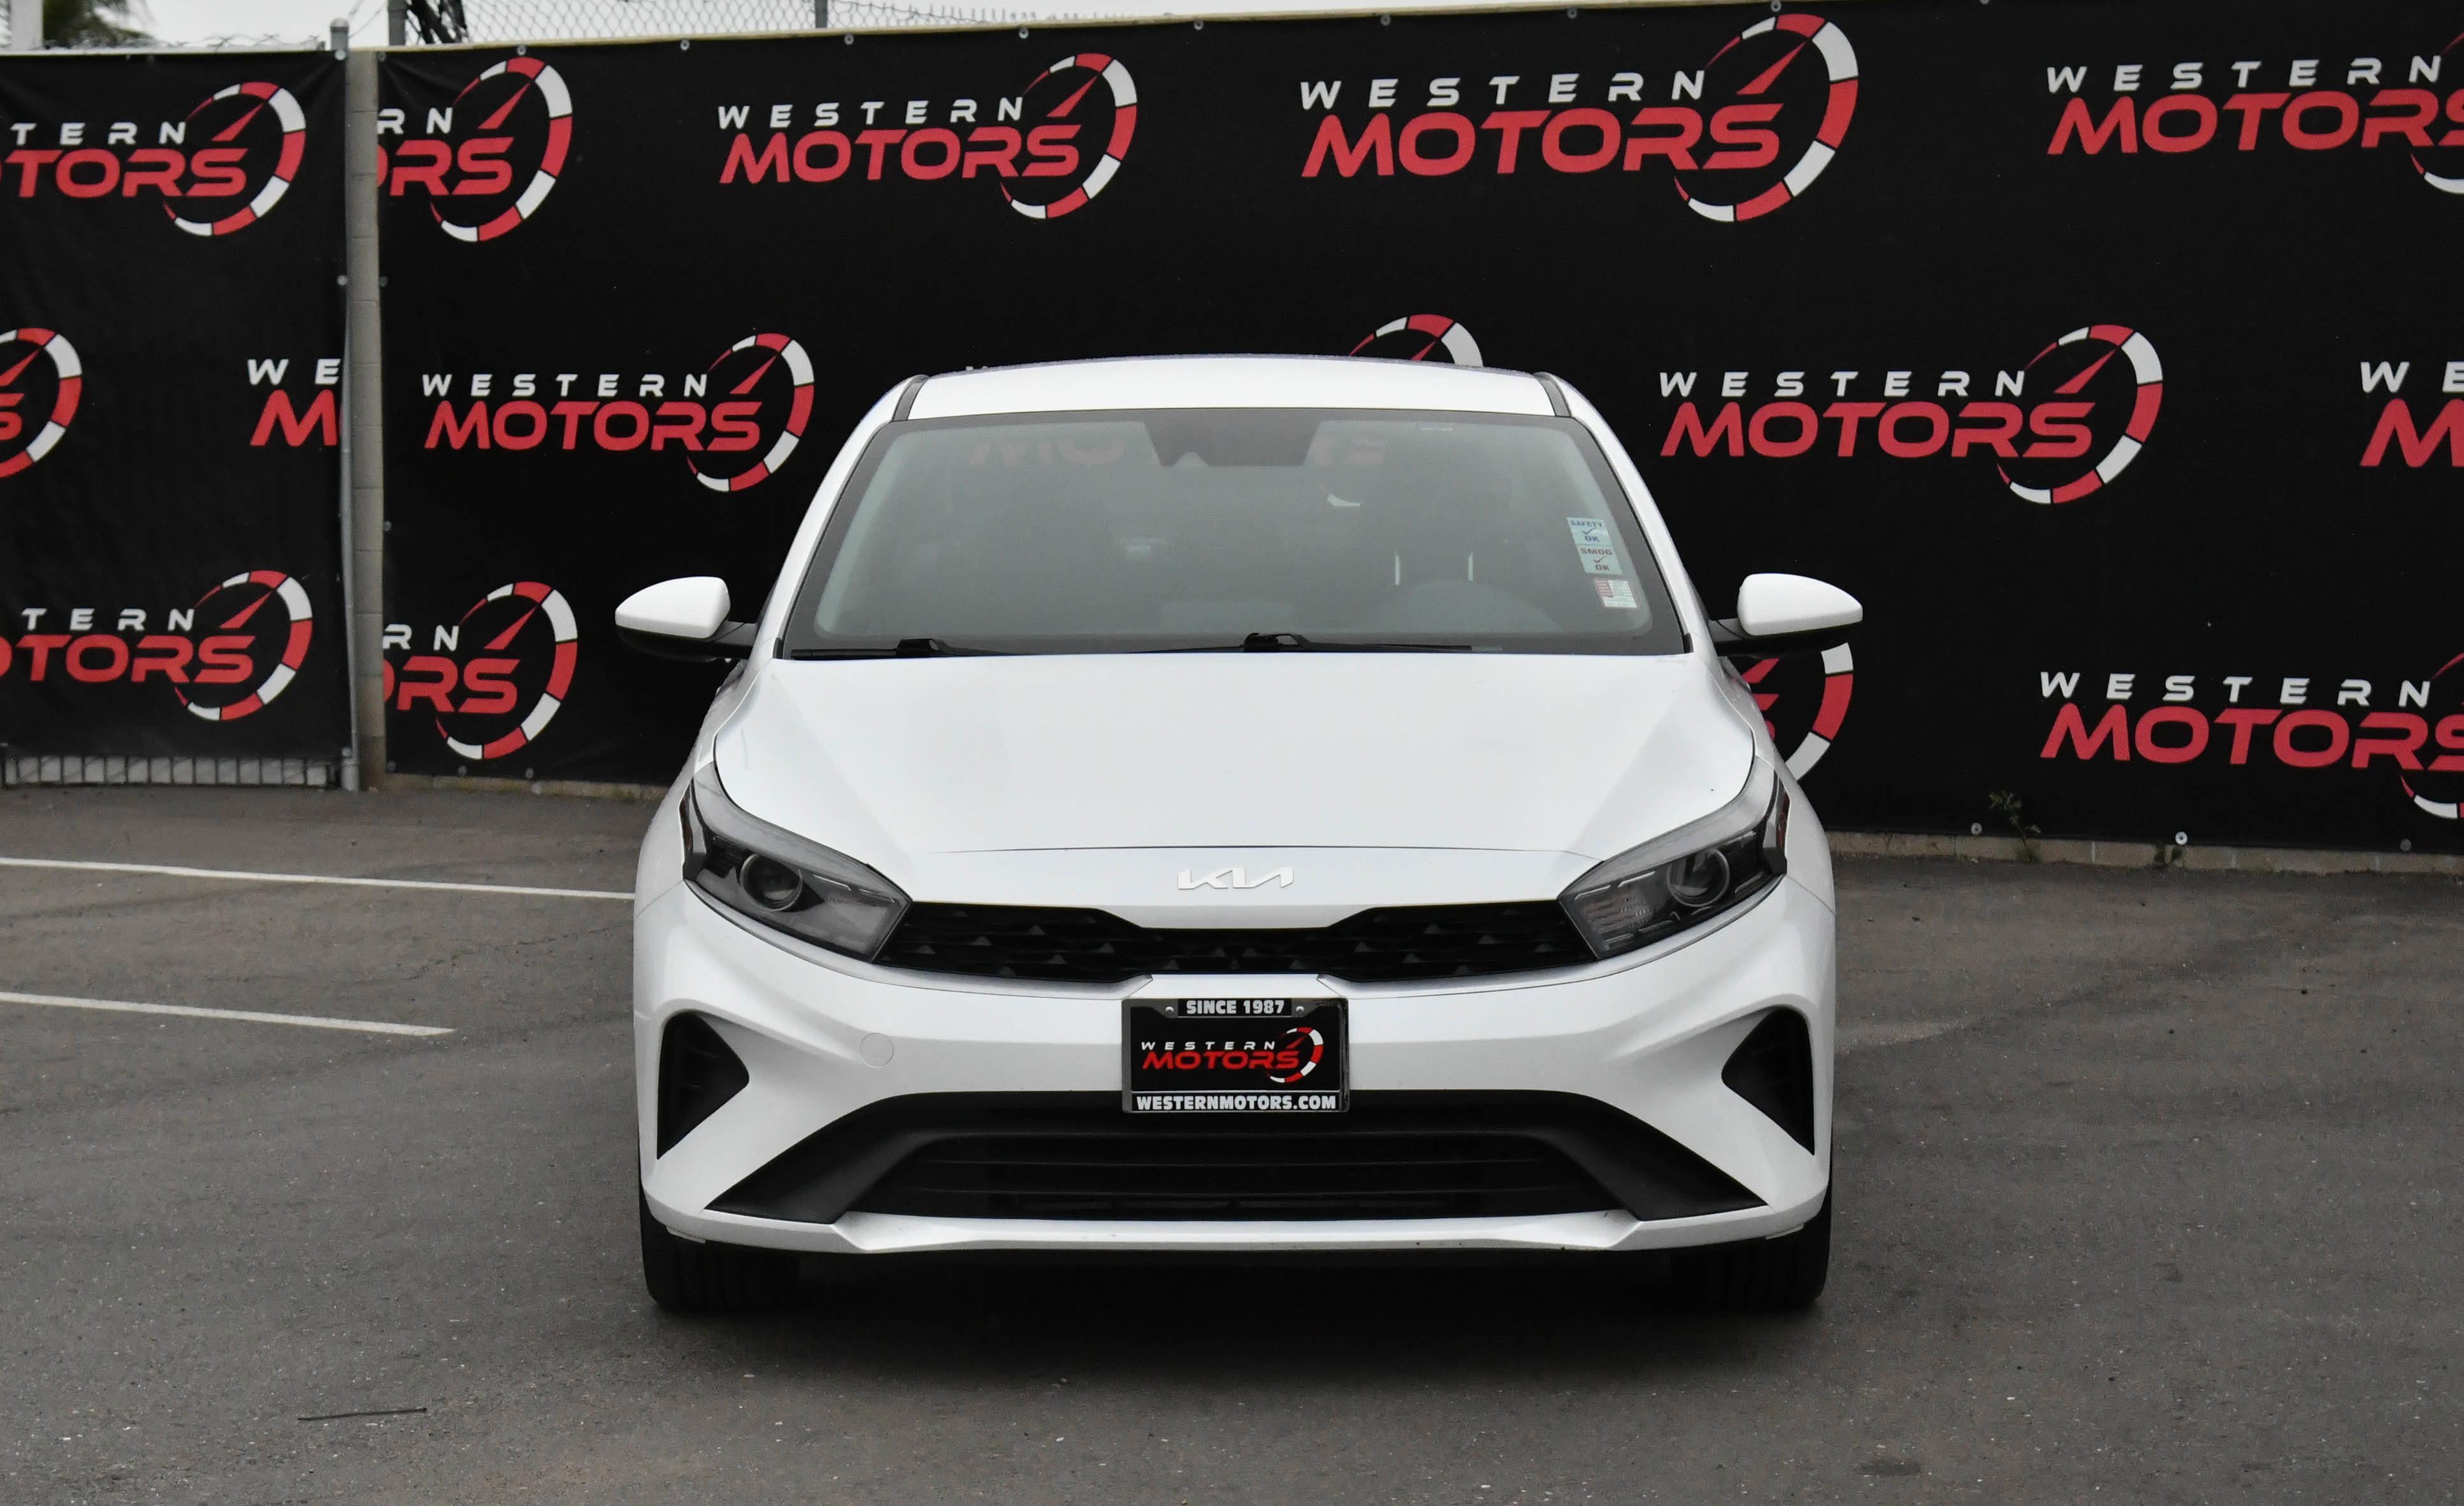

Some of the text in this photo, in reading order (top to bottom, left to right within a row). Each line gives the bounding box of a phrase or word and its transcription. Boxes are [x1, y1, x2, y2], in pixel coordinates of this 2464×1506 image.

[1301, 70, 1704, 109] WESTERN
[2047, 56, 2440, 92] WESTERN
[719, 97, 1022, 129] WESTERN
[720, 125, 1081, 184] MOTORS
[1302, 103, 1783, 177] MOTORS
[0, 148, 247, 198] TORS
[377, 137, 514, 196] RS
[422, 374, 707, 396] WESTERN
[1660, 371, 2024, 396] WESTERN
[425, 400, 762, 451] MOTORS
[1661, 402, 2095, 458] MOTORS
[1569, 519, 1603, 528] SAFETY
[1580, 547, 1613, 556] SMOG
[0, 634, 255, 683] TORS
[383, 656, 520, 714] RS
[2041, 672, 2430, 707] WESTERN
[1178, 866, 1294, 890] KIA
[1186, 999, 1285, 1015] SINCE 1987
[1142, 1041, 1274, 1050] WESTERN
[1142, 1050, 1300, 1070] MOTORS
[1137, 1095, 1336, 1111] WESTERNMOTORS.COM
